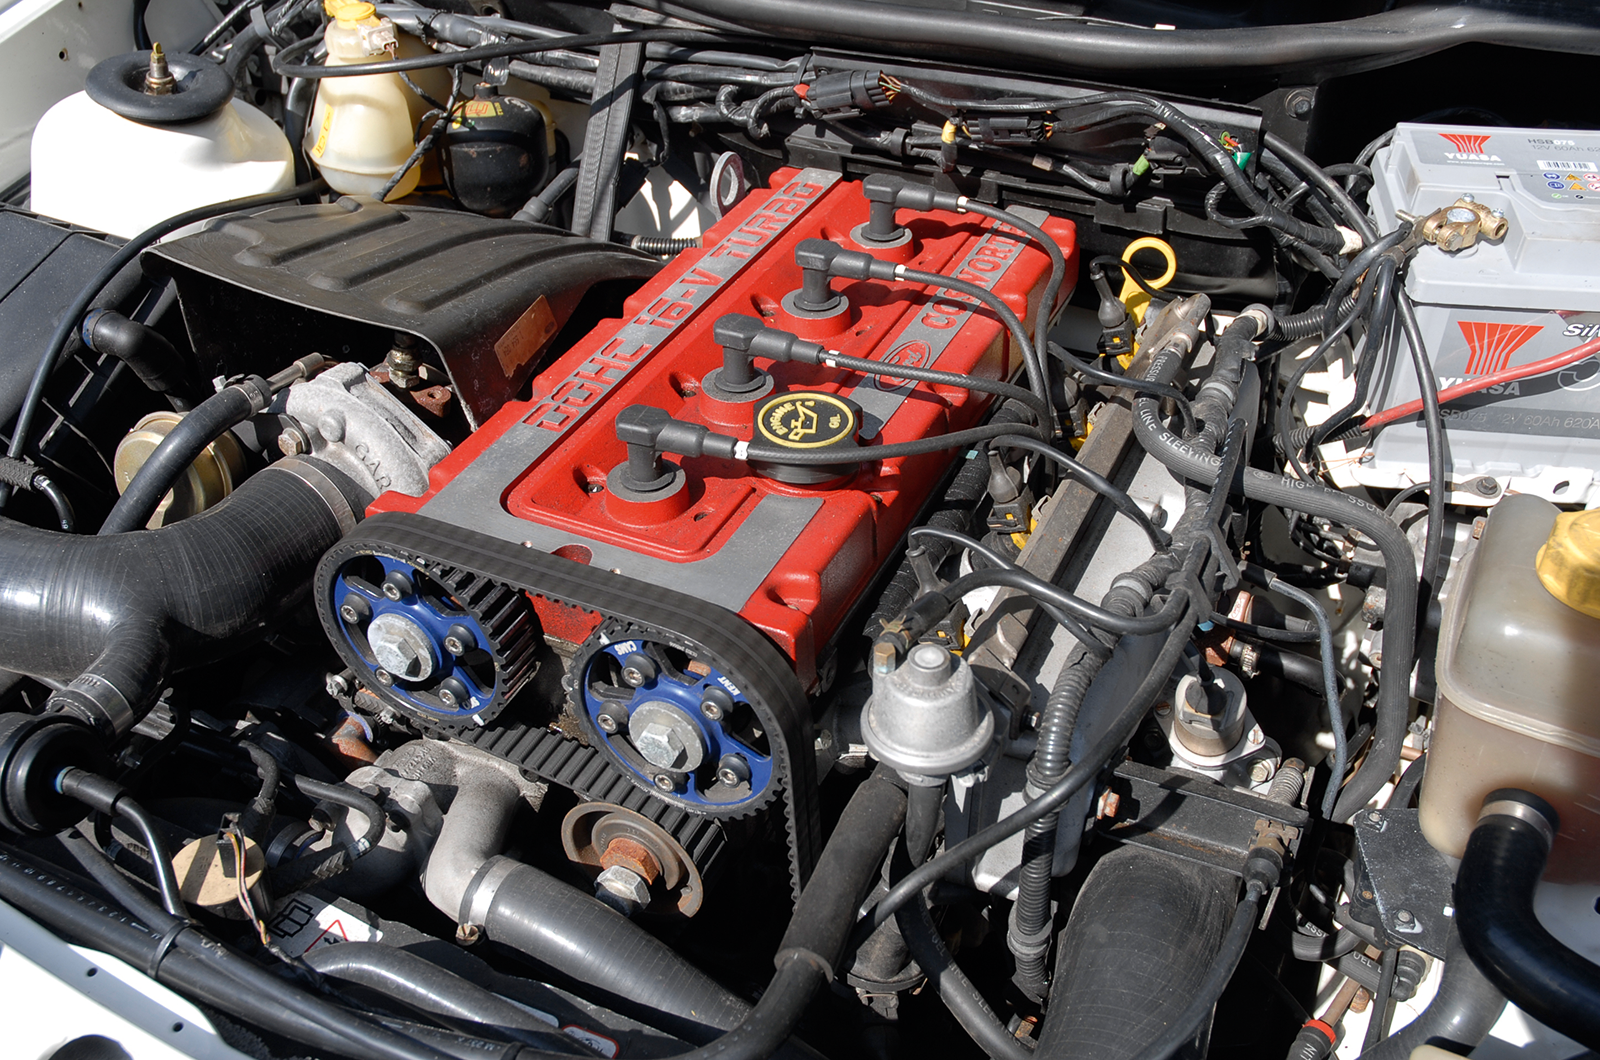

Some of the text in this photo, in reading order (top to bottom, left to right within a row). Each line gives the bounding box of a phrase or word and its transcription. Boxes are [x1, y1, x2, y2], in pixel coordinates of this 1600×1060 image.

[1527, 138, 1576, 146] HSB075
[1444, 152, 1502, 162] YUASA
[521, 337, 653, 432] DOHC
[710, 181, 824, 260] TURBO
[1145, 355, 1168, 382] PRESSUR
[1438, 376, 1521, 396] YSA
[769, 402, 841, 436] ENGINE OIL
[1438, 408, 1487, 422] SB075
[1524, 414, 1560, 428] 60Ah
[614, 640, 741, 696] KENT CAMS
